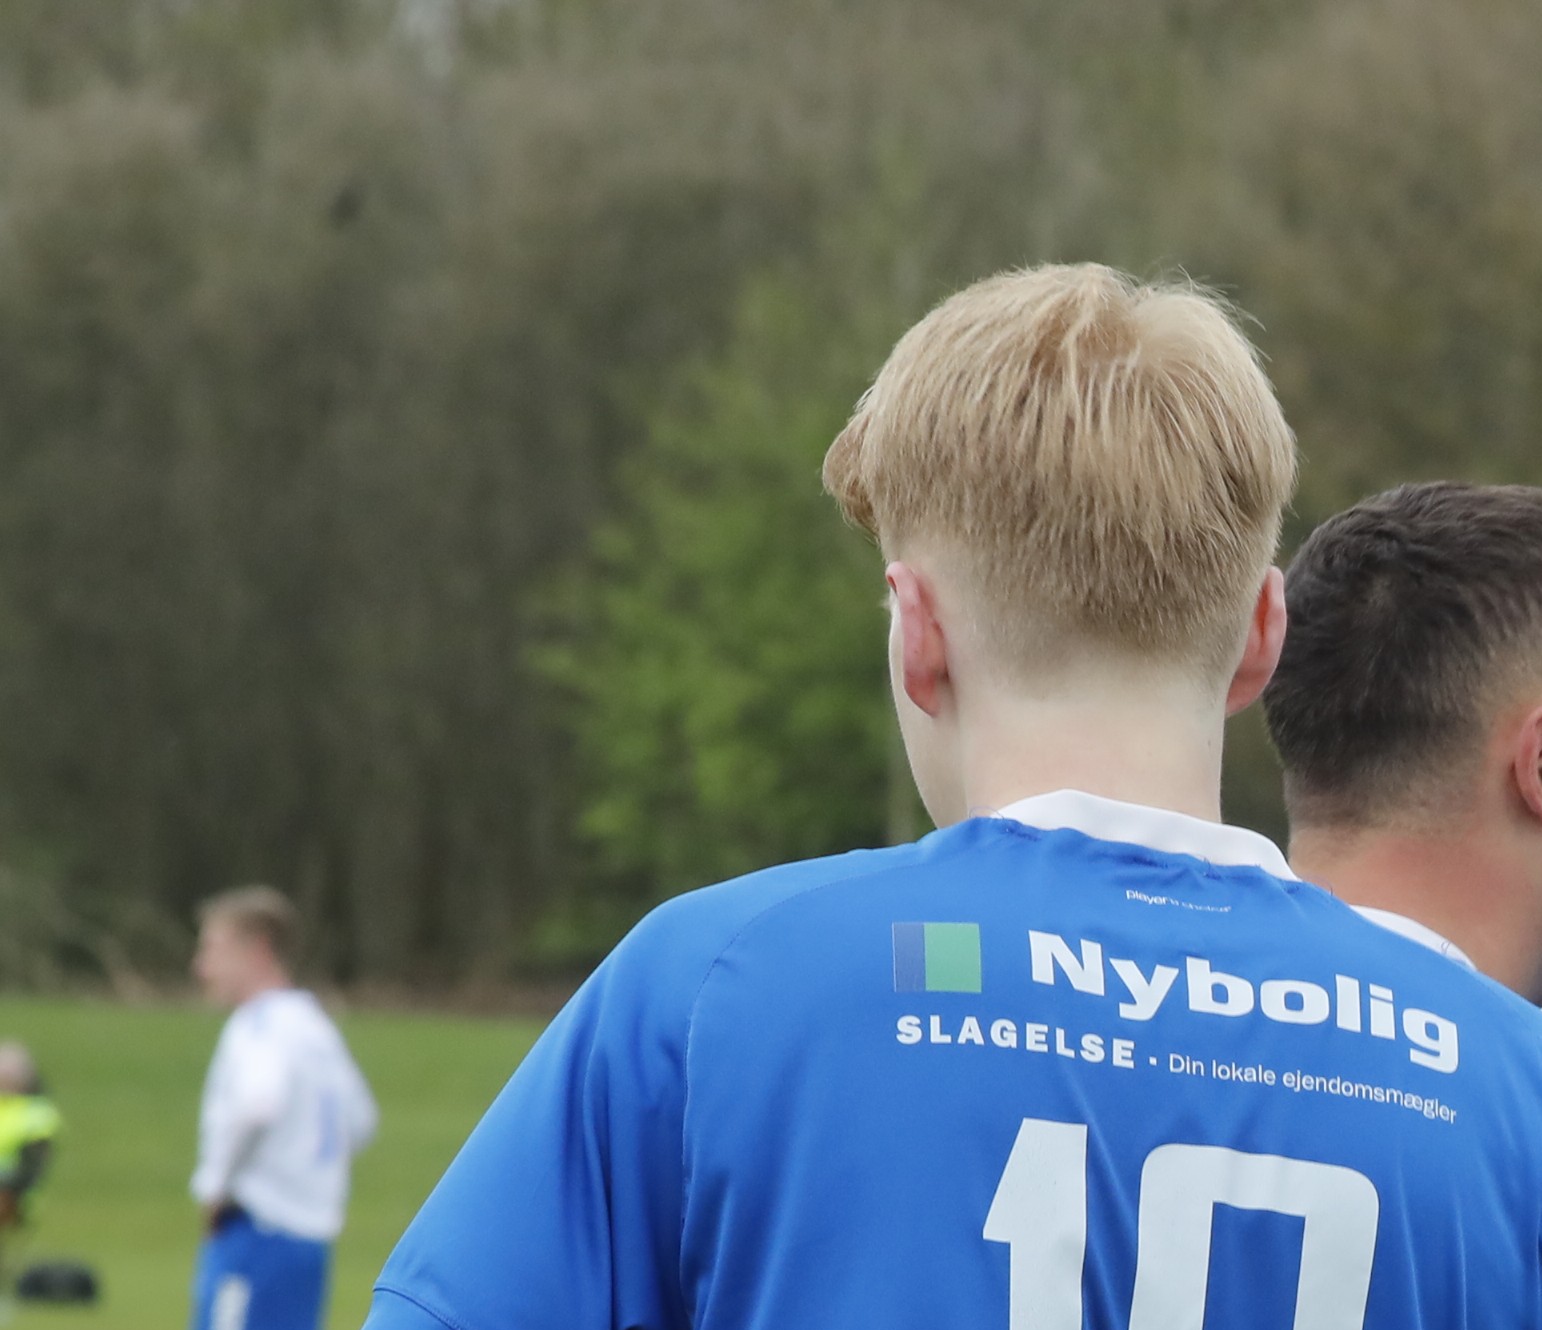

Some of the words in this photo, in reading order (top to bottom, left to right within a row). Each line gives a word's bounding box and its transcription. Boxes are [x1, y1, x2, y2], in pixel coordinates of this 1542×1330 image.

[1028, 929, 1459, 1074] Nybolig
[896, 1015, 1136, 1069] SLAGELSE
[1169, 1053, 1205, 1077] Din
[1211, 1058, 1276, 1086] lokale
[1282, 1070, 1457, 1125] ejendomsmægler
